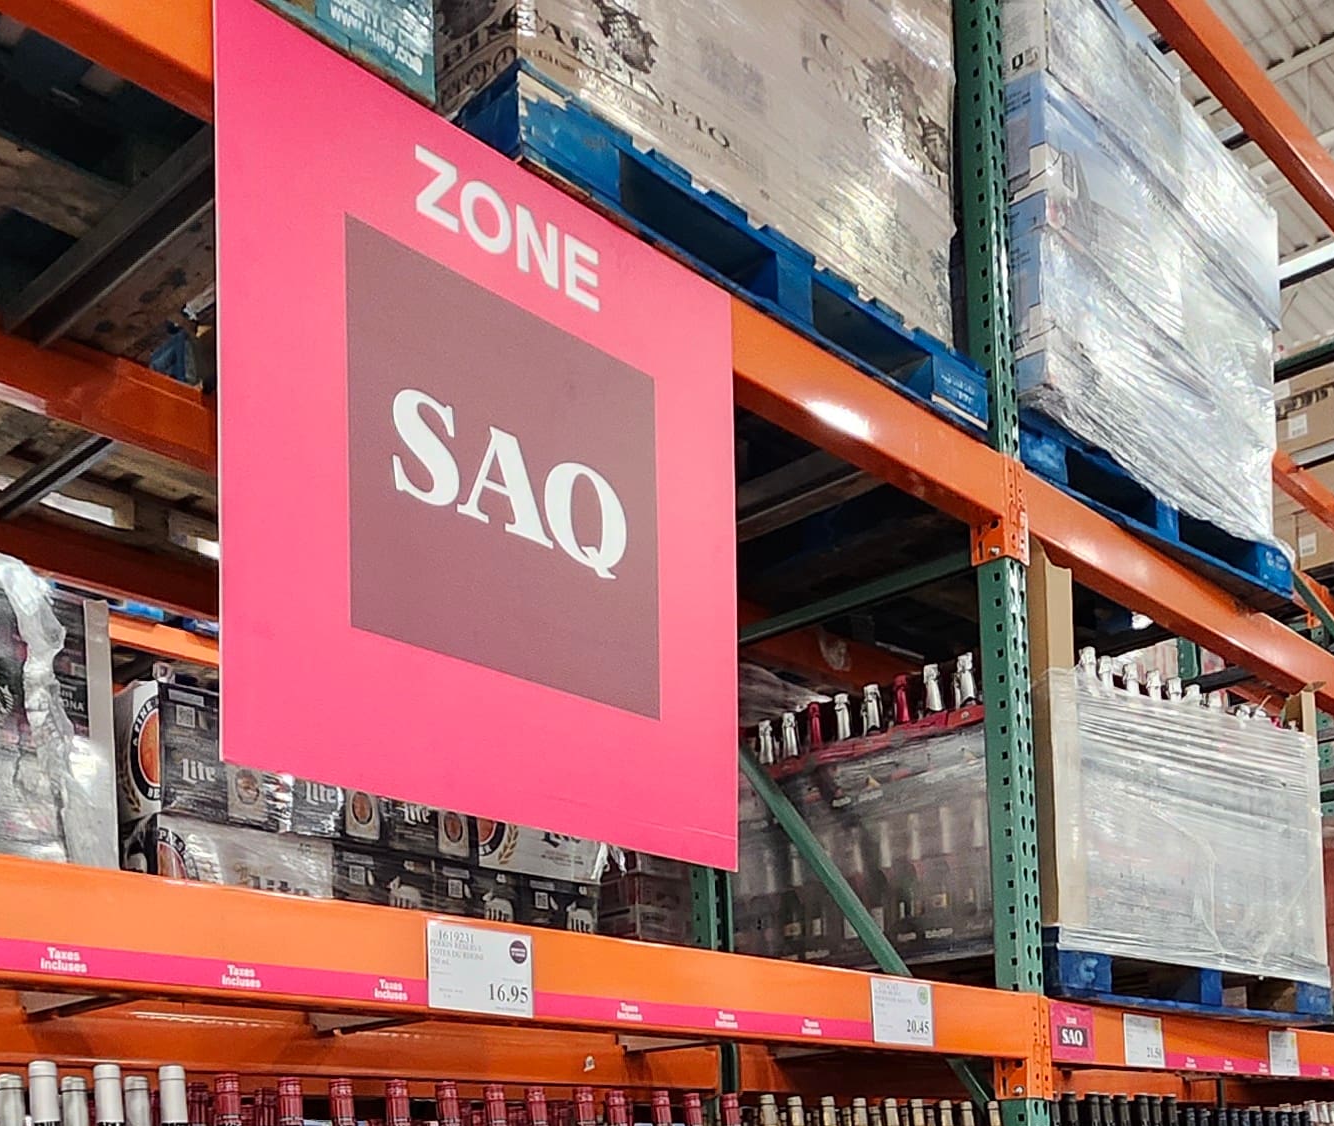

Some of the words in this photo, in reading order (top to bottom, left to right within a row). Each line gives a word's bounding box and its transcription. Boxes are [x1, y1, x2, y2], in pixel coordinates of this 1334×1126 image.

[415, 145, 600, 312] ZONE
[392, 388, 628, 580] SAQ
[181, 757, 216, 785] Lite
[438, 930, 474, 944] 1619231
[47, 947, 80, 962] Taxes
[227, 964, 255, 978] Taxes
[489, 983, 529, 1004] 16.95
[906, 1018, 931, 1035] 20.45
[1061, 1029, 1084, 1046] SAQ
